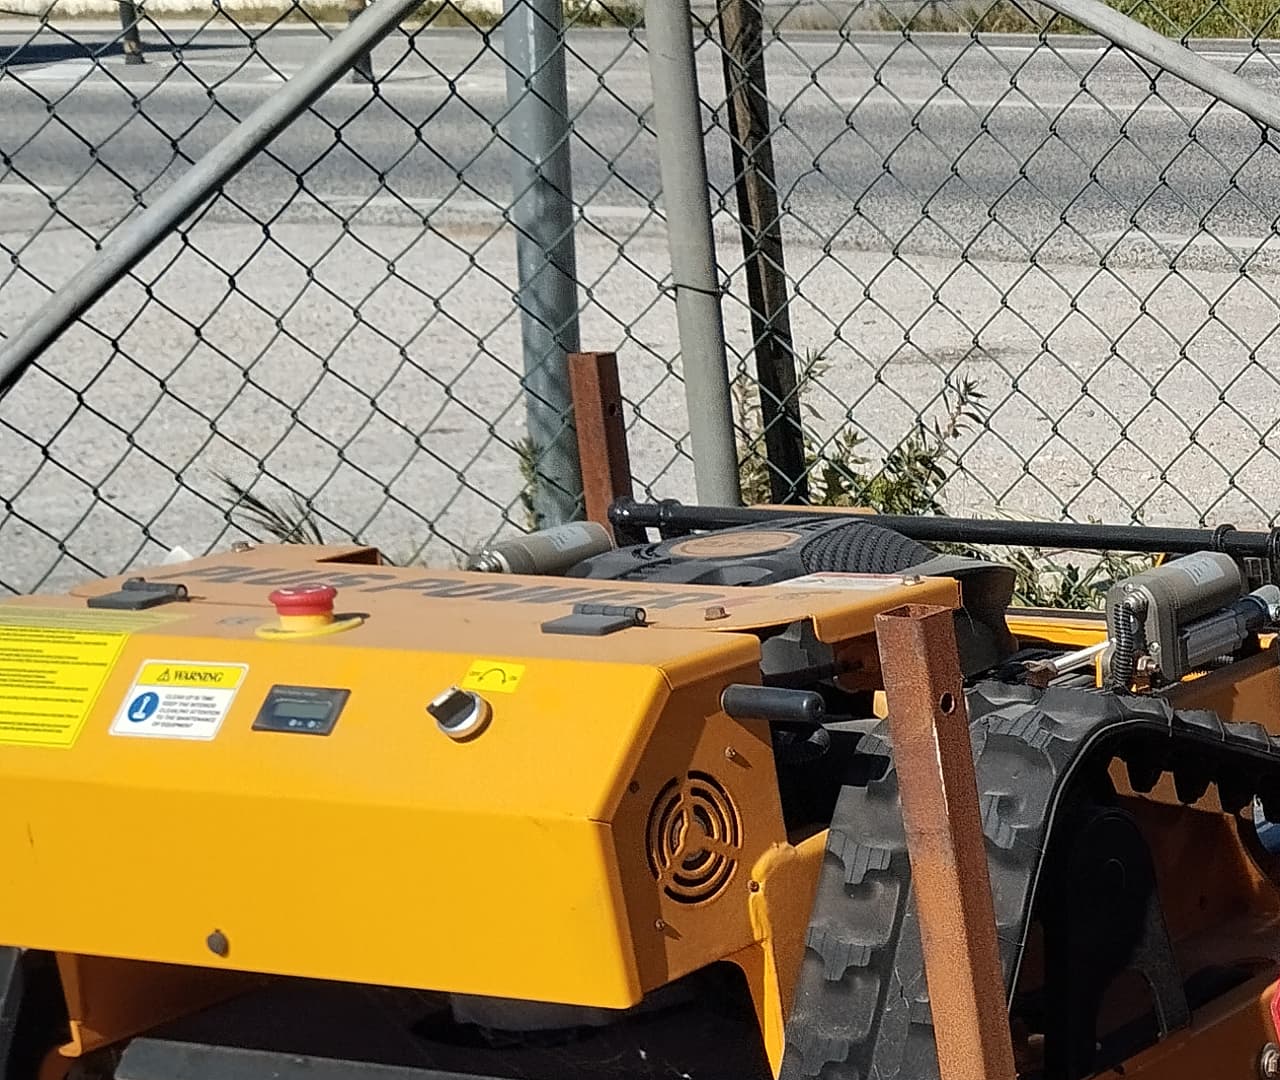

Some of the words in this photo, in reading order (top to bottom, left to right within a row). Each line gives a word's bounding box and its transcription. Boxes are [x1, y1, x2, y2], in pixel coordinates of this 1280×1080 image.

[150, 565, 394, 589] PLUS
[361, 577, 724, 610] POWER
[174, 670, 224, 682] WARNING
